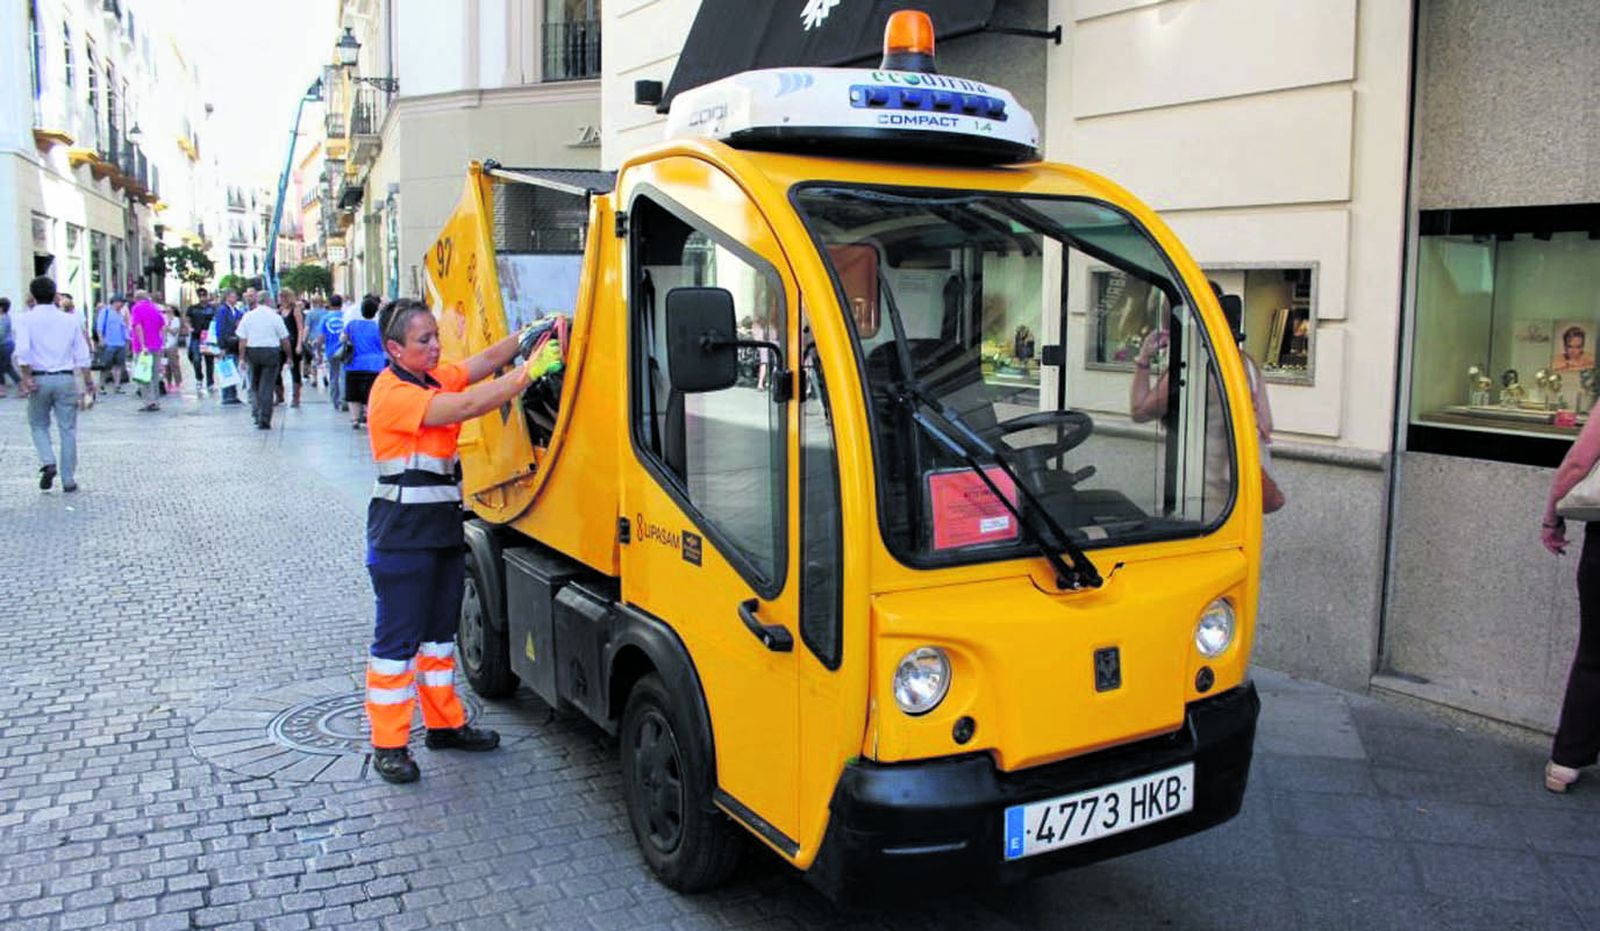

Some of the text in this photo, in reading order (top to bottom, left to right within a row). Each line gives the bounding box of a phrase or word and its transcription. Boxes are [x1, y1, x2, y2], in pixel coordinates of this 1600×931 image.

[878, 115, 959, 127] COMPACT
[437, 237, 452, 278] 97
[644, 522, 680, 549] LIPASAM
[1011, 776, 1181, 849] E 4773 HKB
